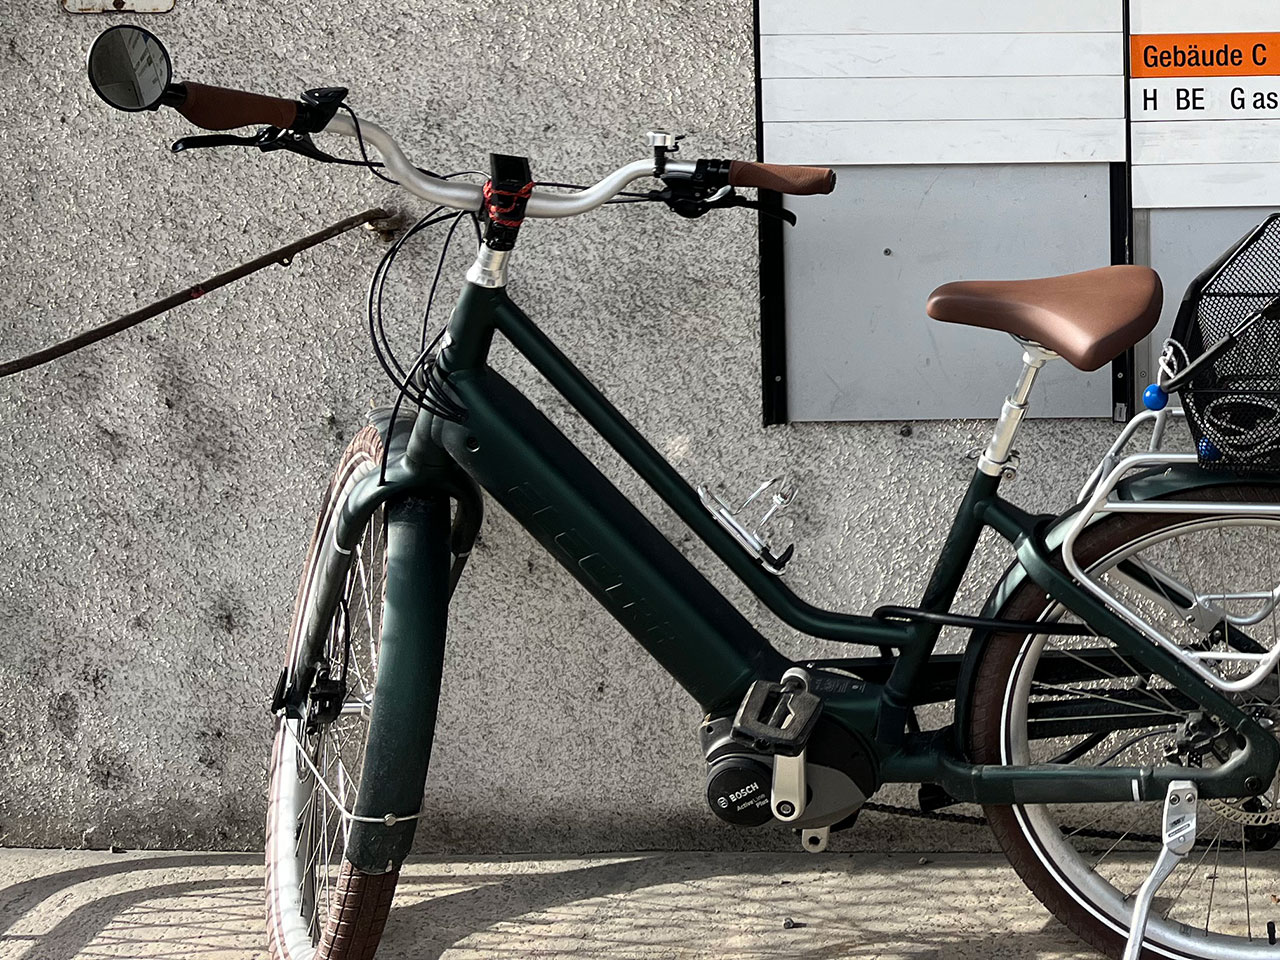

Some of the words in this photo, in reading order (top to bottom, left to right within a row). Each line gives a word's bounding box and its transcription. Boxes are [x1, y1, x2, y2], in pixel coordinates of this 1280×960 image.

[1144, 44, 1242, 67] Gebäude
[1253, 44, 1266, 65] C
[729, 782, 759, 802] BOSCH
